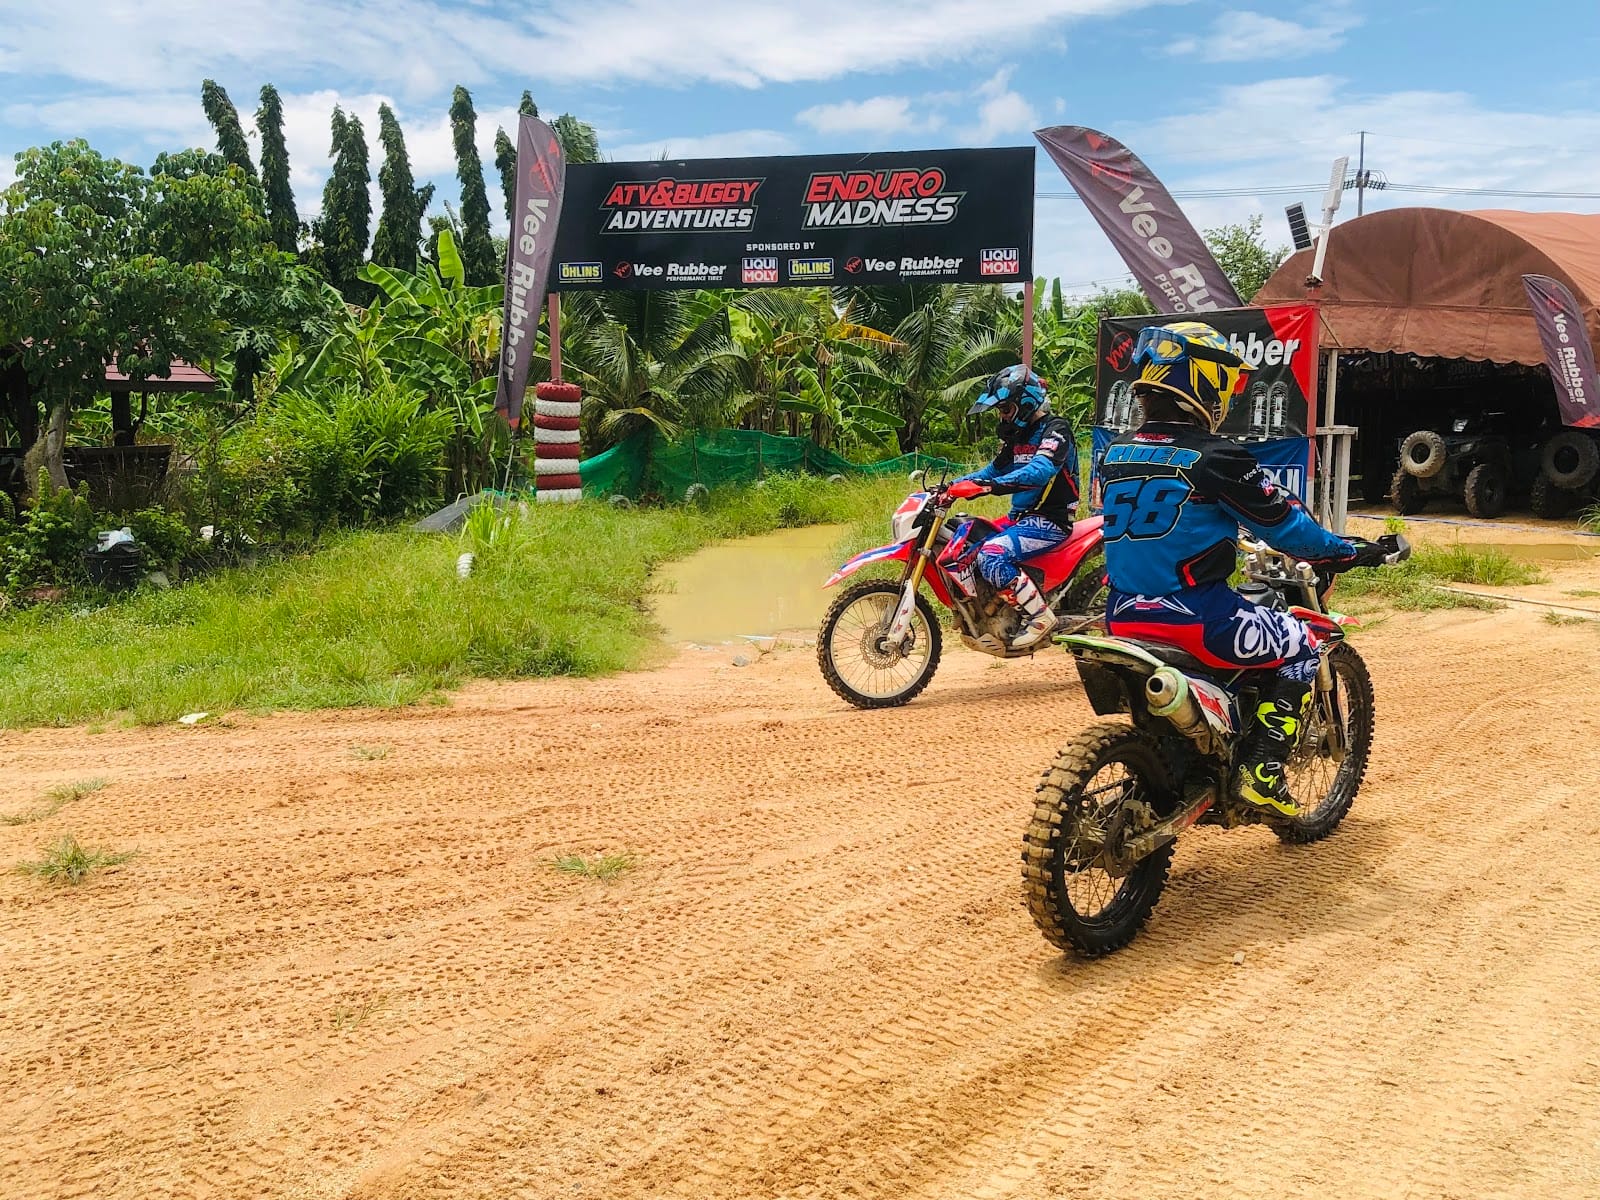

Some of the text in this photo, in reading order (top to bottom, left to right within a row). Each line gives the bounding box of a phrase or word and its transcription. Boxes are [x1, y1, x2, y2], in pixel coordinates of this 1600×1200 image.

[606, 180, 761, 207] ATV&BUGGY
[806, 170, 944, 202] ENDURO
[607, 208, 753, 230] ADVENTURES
[806, 197, 959, 226] MADNESS
[1118, 186, 1174, 259] Vee
[746, 242, 816, 251] SPONSORED BY
[982, 250, 1017, 262] LIQUI
[561, 264, 600, 278] ÖHLINS
[633, 262, 727, 276] Vee Rubber
[743, 259, 776, 270] LIQUI
[791, 260, 831, 274] ÖHLINS
[864, 256, 963, 272] Vee Rubber
[982, 261, 1017, 274] MOLY
[666, 274, 707, 282] PERFORMANCE
[743, 270, 777, 281] MOLY
[899, 269, 942, 277] PERFORMANCE
[503, 199, 549, 383] Vee Rubber
[1553, 313, 1587, 404] Vee Rubber
[1104, 444, 1202, 469] RIDER
[1103, 477, 1192, 541] 58
